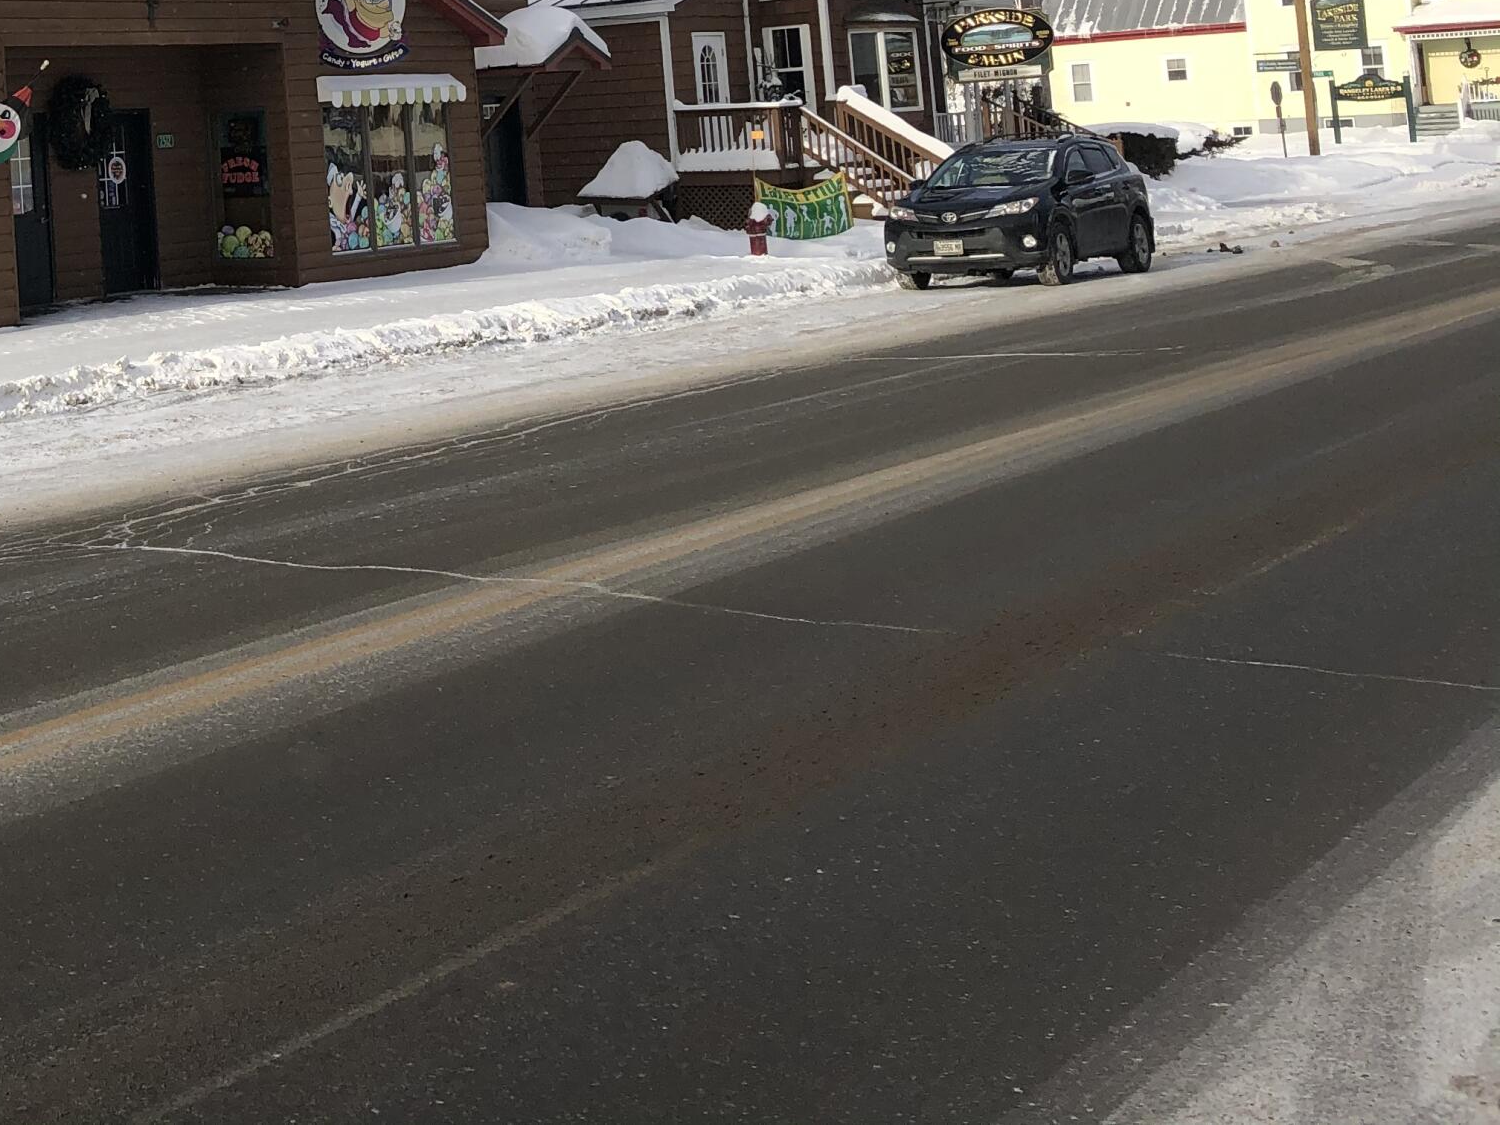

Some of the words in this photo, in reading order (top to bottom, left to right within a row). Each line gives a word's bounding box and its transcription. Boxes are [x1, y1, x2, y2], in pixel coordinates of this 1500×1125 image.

[1316, 3, 1359, 21] LAKESIDE
[1333, 14, 1358, 23] PARK
[954, 11, 1035, 33] PARKSIDE
[995, 41, 1039, 50] SPIRITS
[322, 53, 345, 66] Candy
[350, 58, 378, 68] Yogurt
[383, 48, 404, 63] Gifts
[980, 50, 1025, 66] MAIN
[220, 156, 260, 172] FRESH
[221, 171, 260, 184] FUDGE
